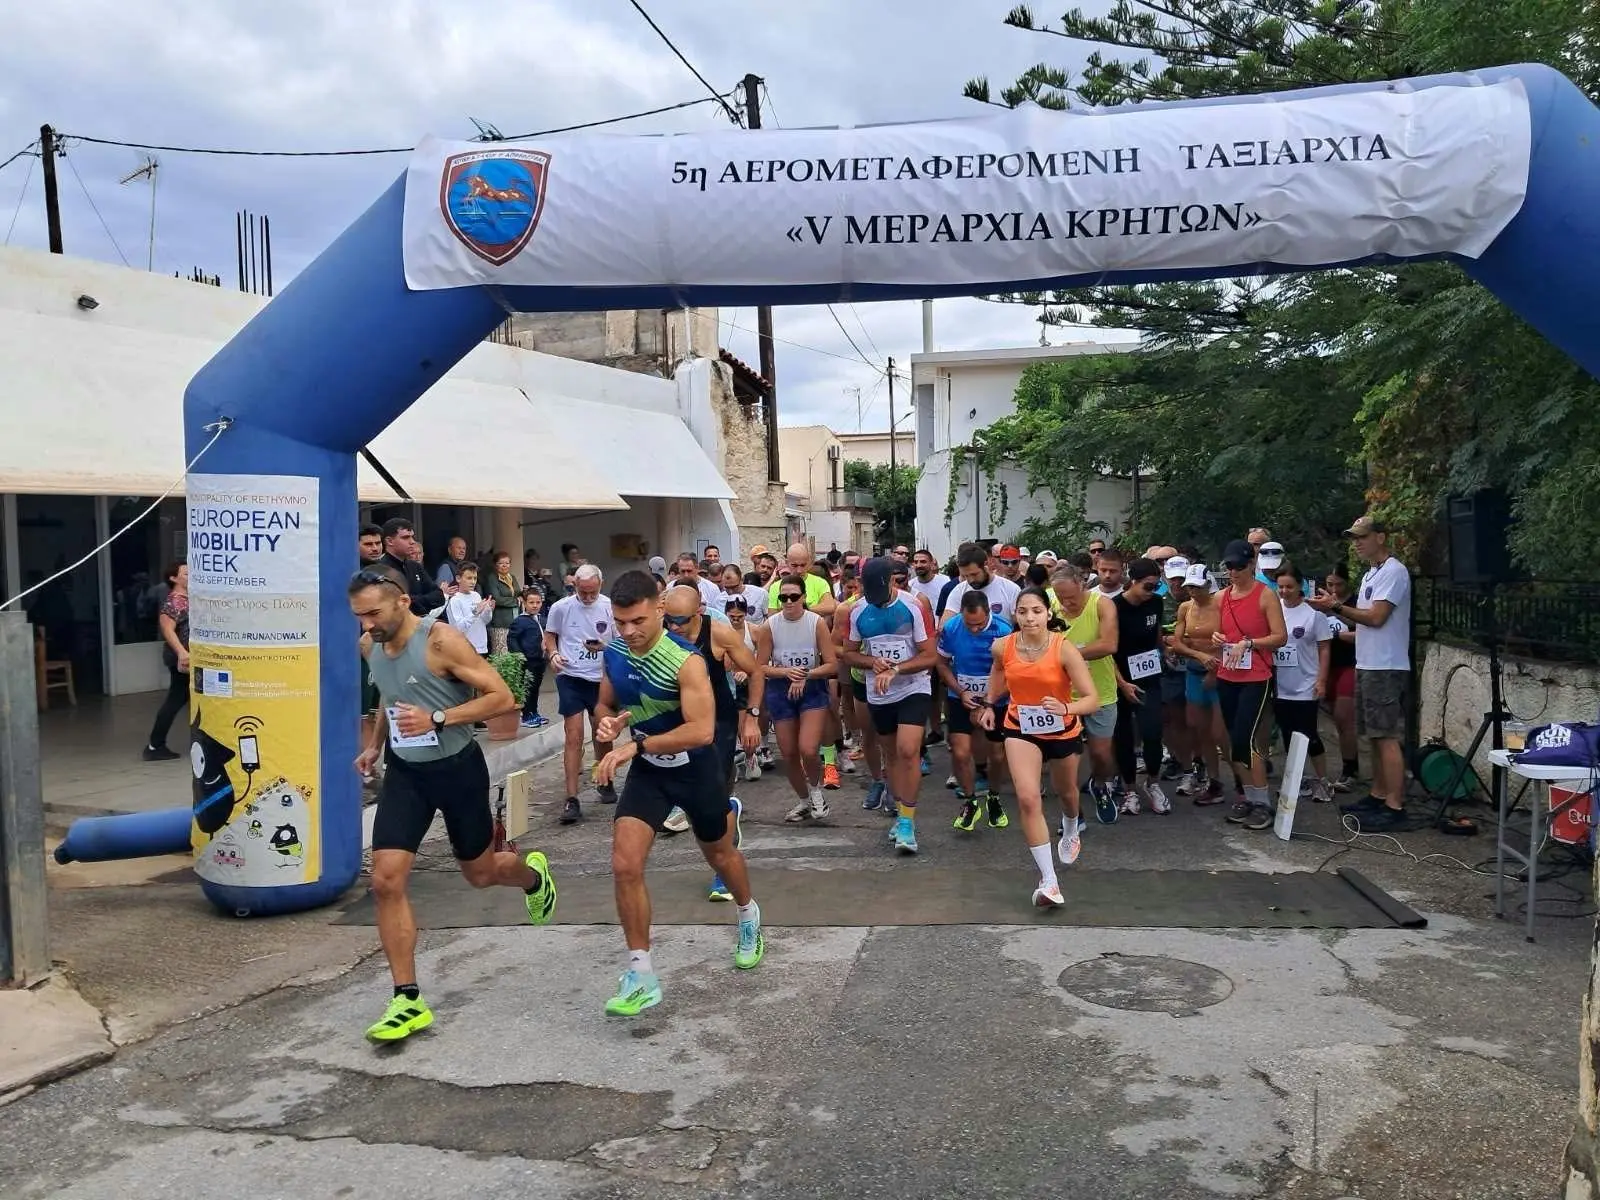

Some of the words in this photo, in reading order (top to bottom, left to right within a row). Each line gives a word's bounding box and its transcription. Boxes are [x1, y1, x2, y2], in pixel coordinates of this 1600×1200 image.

[672, 161, 707, 191] 5η
[718, 147, 1140, 183] ΑΕΡΟΜΕΤΑΦΕΡΟΜΕΝΗ
[1179, 133, 1392, 171] ΤΑΞΙΑΡΧΙΑ
[844, 211, 1053, 244] ΜΕΡΑΡΧΙΑ
[1065, 202, 1263, 239] ΚΡΗΤΩΝ»
[251, 495, 308, 505] RETHYMNO
[191, 508, 300, 529] EUROPEAN
[191, 532, 281, 552] MOBILITY
[192, 553, 238, 573] WEEK
[206, 576, 267, 586] SEPTEMBER
[241, 631, 308, 641] #RUNANDWALK
[578, 650, 598, 660] 240
[879, 649, 900, 660] 175
[788, 656, 809, 667] 193
[1136, 659, 1154, 672] 160
[965, 682, 986, 692] 207
[1027, 714, 1055, 727] 189
